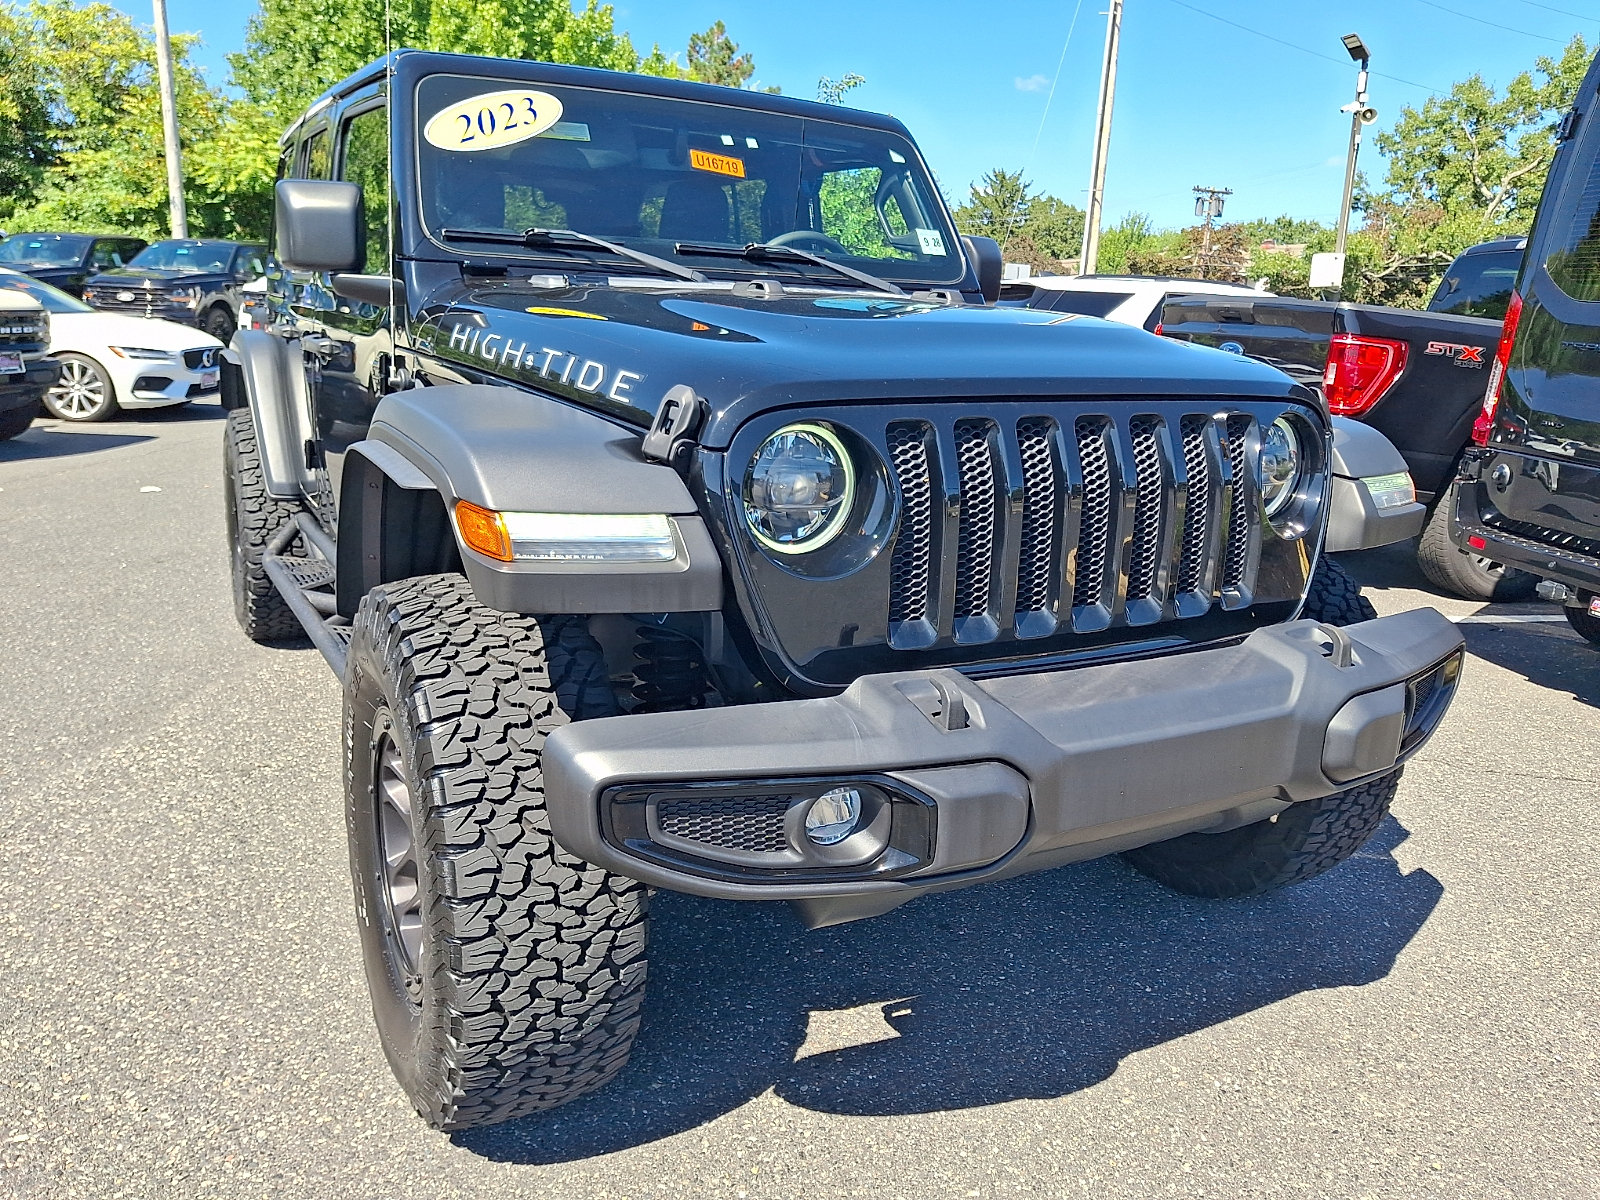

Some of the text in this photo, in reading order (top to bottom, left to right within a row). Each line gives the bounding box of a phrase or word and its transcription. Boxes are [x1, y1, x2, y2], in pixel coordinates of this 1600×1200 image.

[456, 97, 539, 144] 2023
[695, 153, 741, 176] U16719
[448, 323, 642, 404] HIGH TIDE
[1424, 340, 1487, 364] STX
